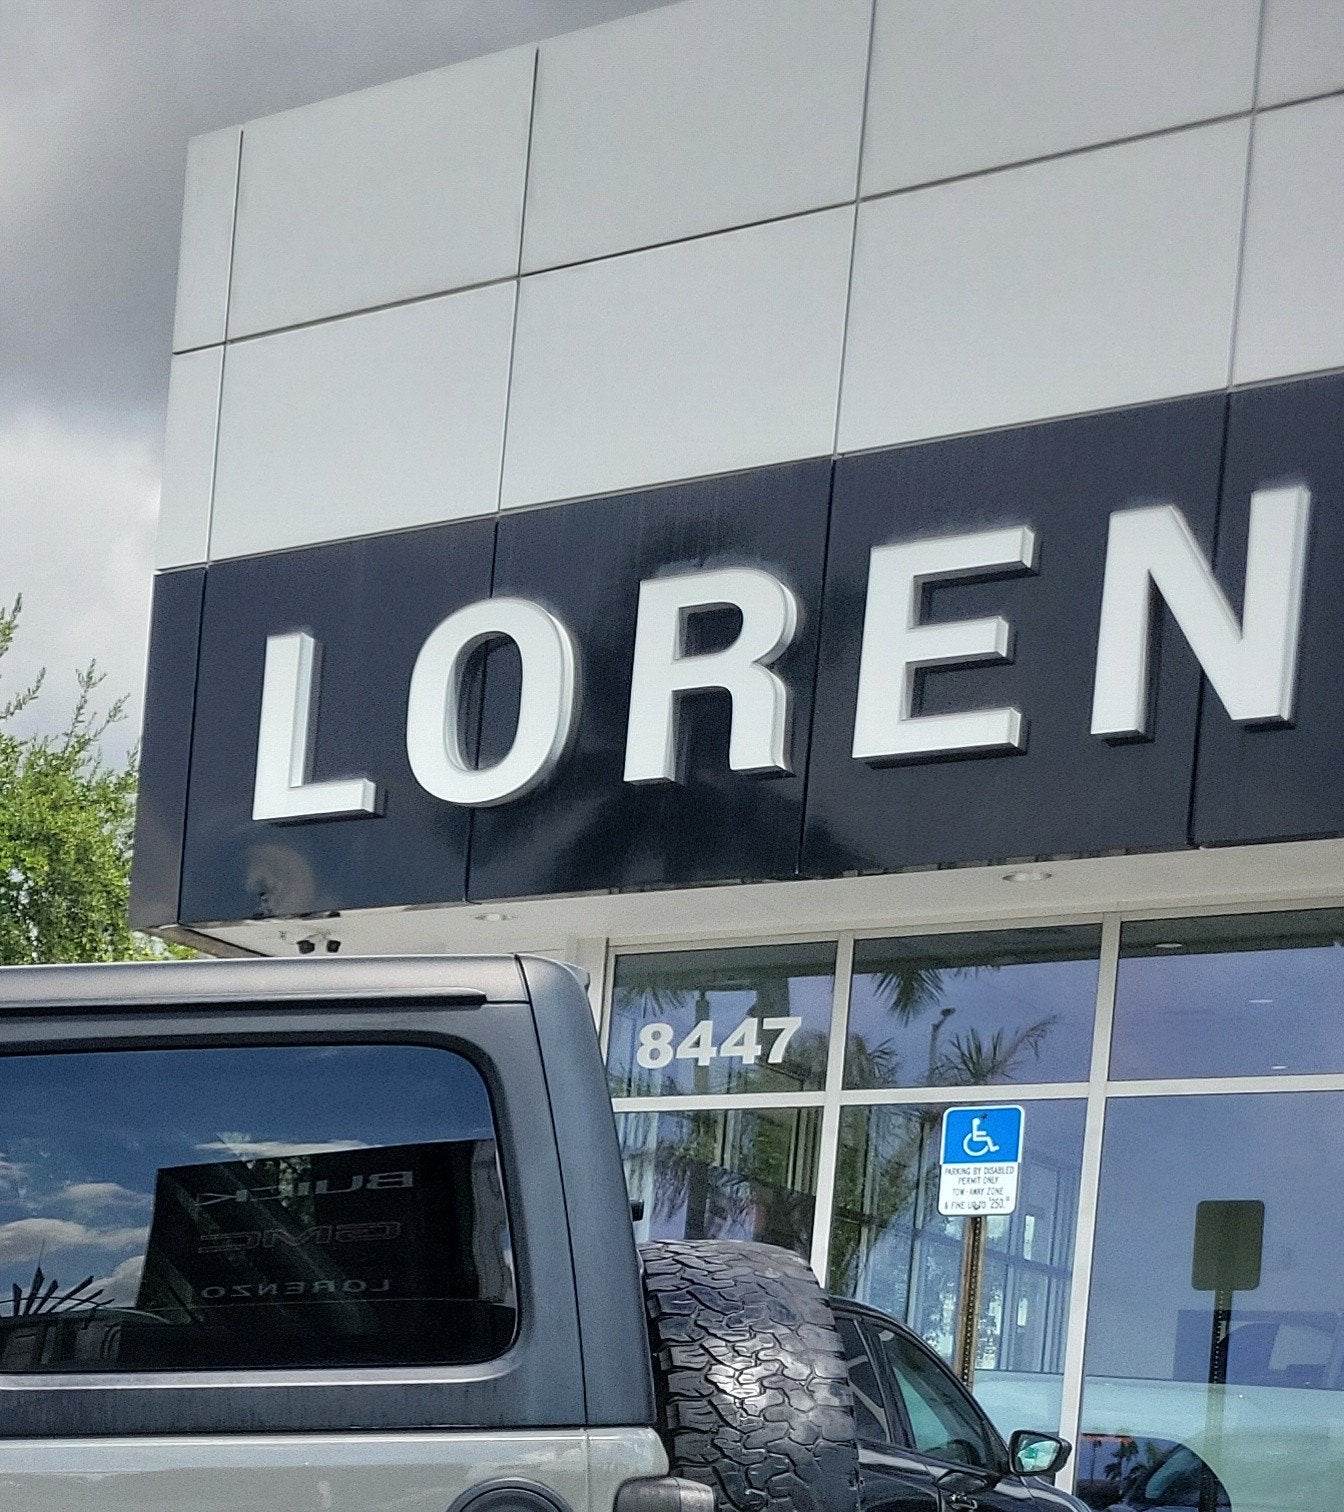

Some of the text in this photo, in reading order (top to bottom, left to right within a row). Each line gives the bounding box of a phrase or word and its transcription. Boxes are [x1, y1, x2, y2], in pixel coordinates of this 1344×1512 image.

[252, 485, 1310, 822] LOREN
[636, 1017, 802, 1069] 8447
[944, 1166, 1014, 1176] PARKING BY DISABLED
[958, 1177, 982, 1185] PERMIT
[987, 1187, 1004, 1195] ZONE
[952, 1202, 965, 1210] FINE
